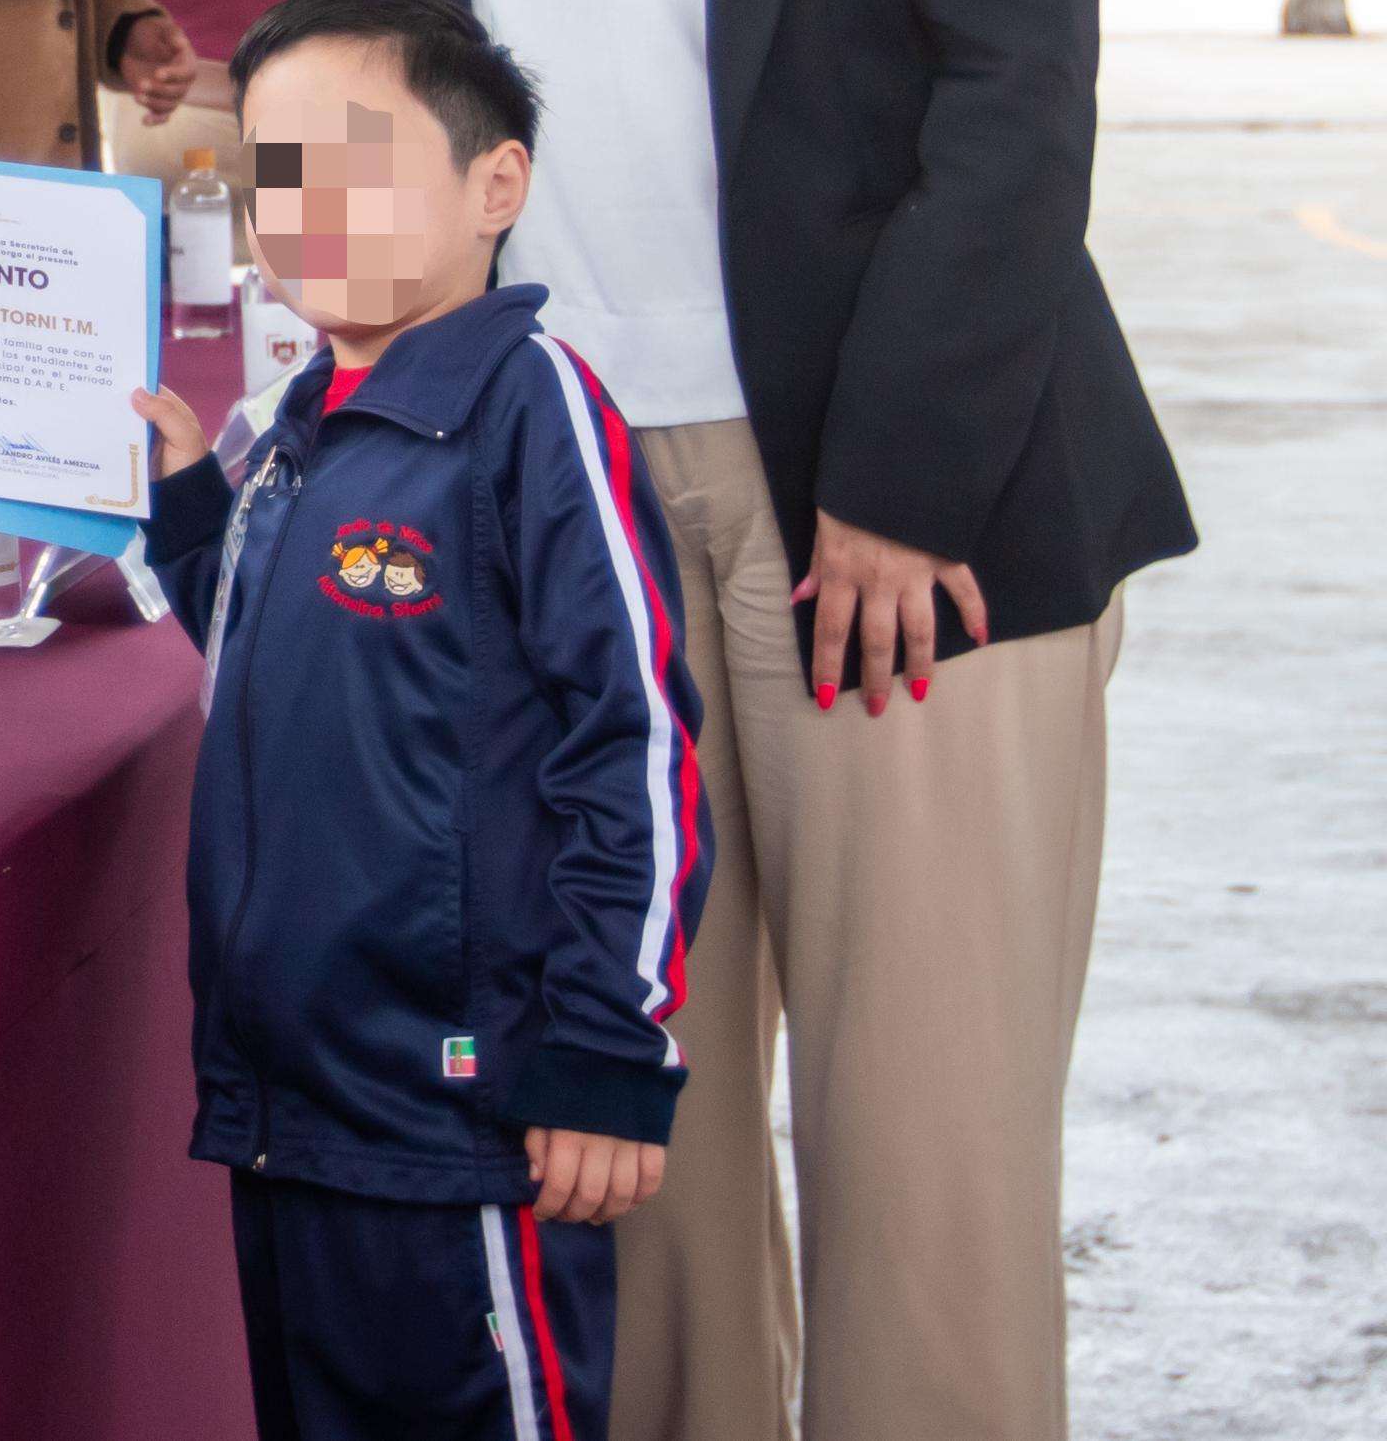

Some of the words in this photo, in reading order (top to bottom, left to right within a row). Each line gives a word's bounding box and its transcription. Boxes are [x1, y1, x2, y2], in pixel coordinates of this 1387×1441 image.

[38, 254, 78, 266] presente
[62, 317, 98, 337] T.M.
[4, 337, 43, 351] familia
[47, 345, 69, 355] que
[73, 349, 94, 359] con
[99, 353, 112, 361] un
[25, 353, 89, 370] estudiantes
[95, 364, 113, 374] del
[31, 368, 45, 376] en
